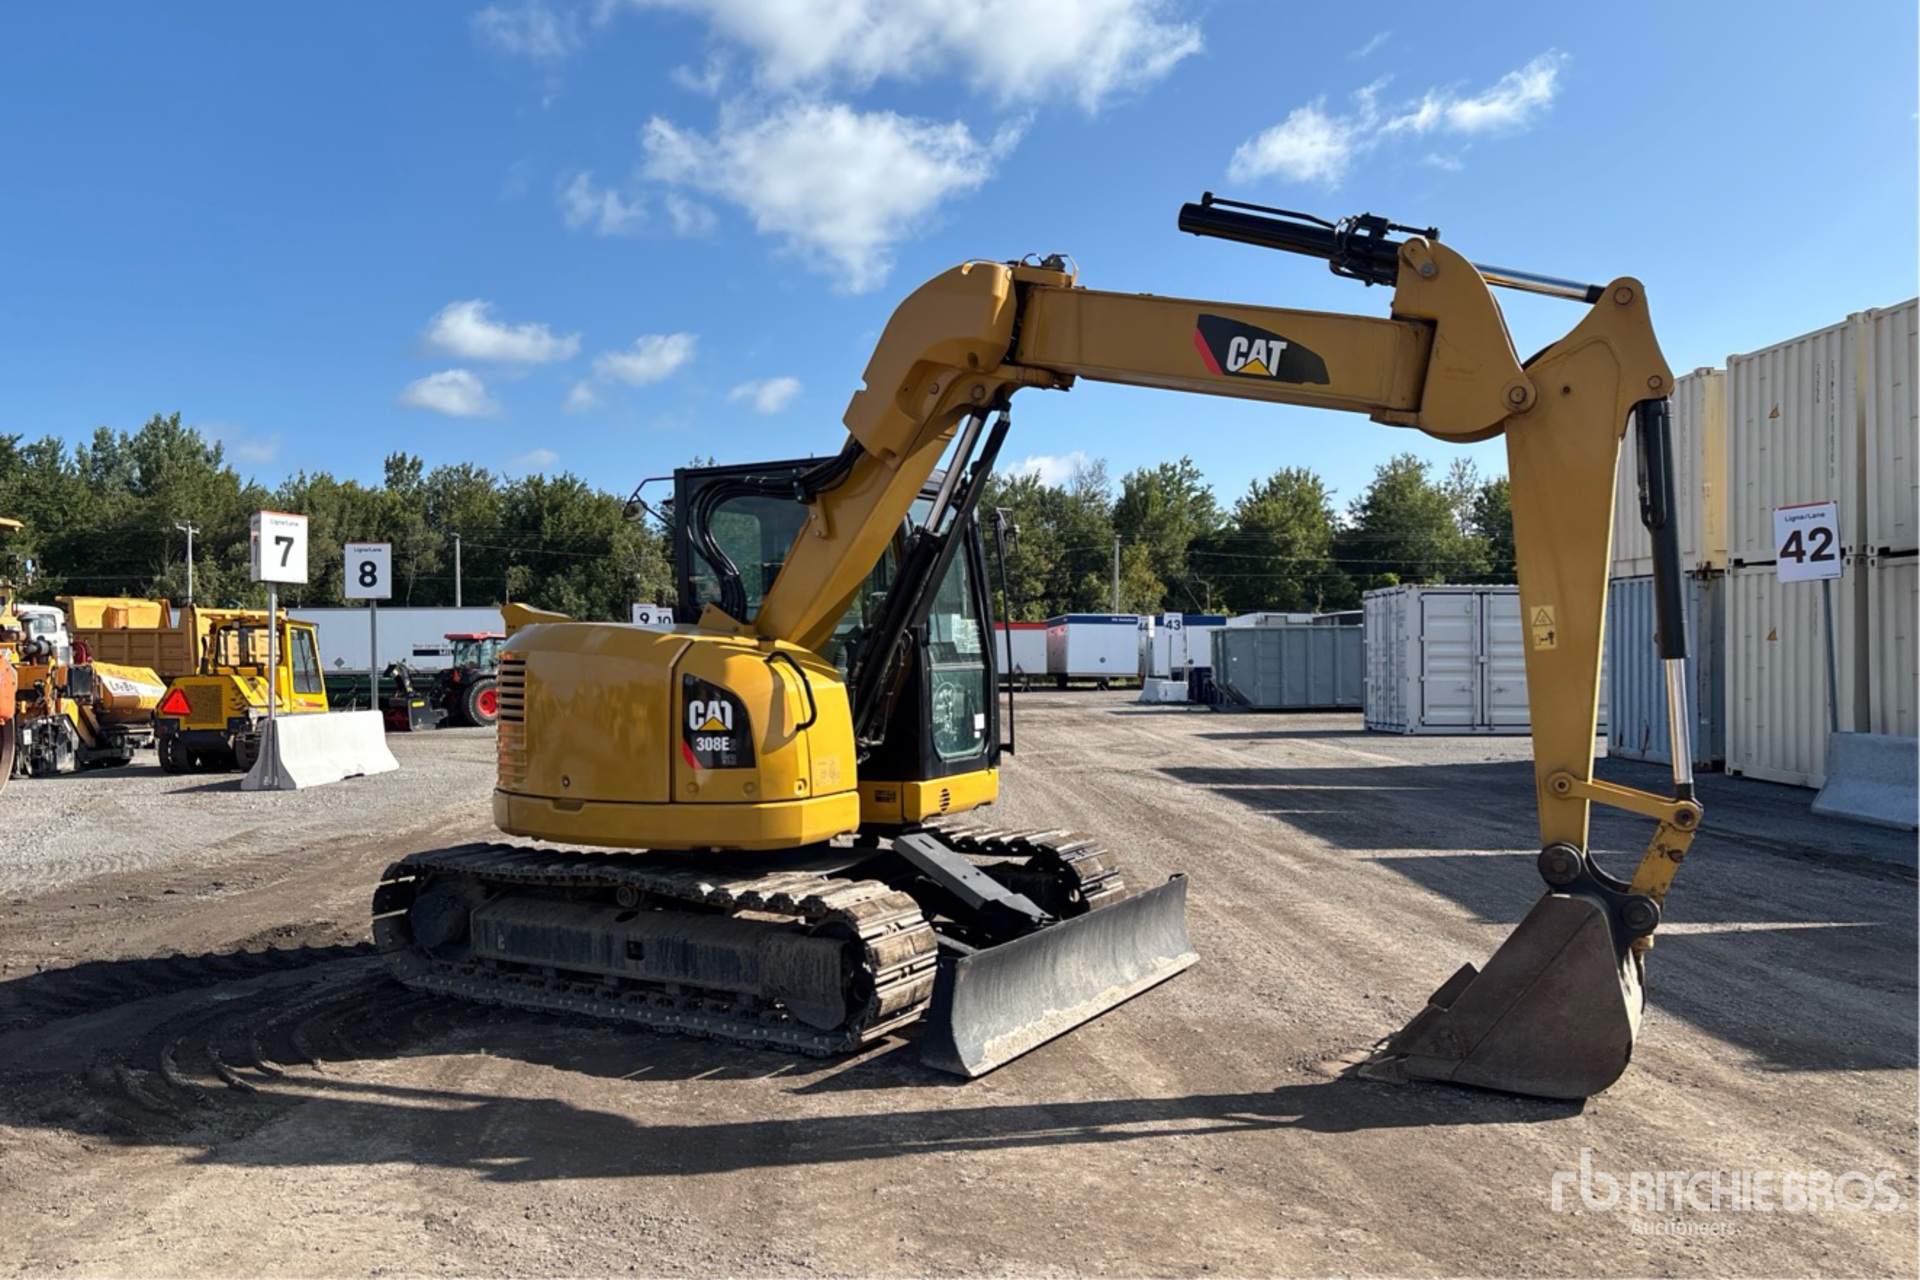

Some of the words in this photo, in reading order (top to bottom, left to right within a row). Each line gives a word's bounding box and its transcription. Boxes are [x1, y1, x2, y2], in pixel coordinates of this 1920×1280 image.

[1226, 336, 1288, 377] CAT
[1784, 512, 1826, 523] Ligne/Lane
[274, 535, 294, 567] 7
[1779, 526, 1835, 564] 42
[358, 560, 378, 588] 8
[639, 611, 650, 625] 9
[656, 616, 672, 625] 10
[1165, 620, 1181, 630] 43
[689, 700, 733, 731] CAT
